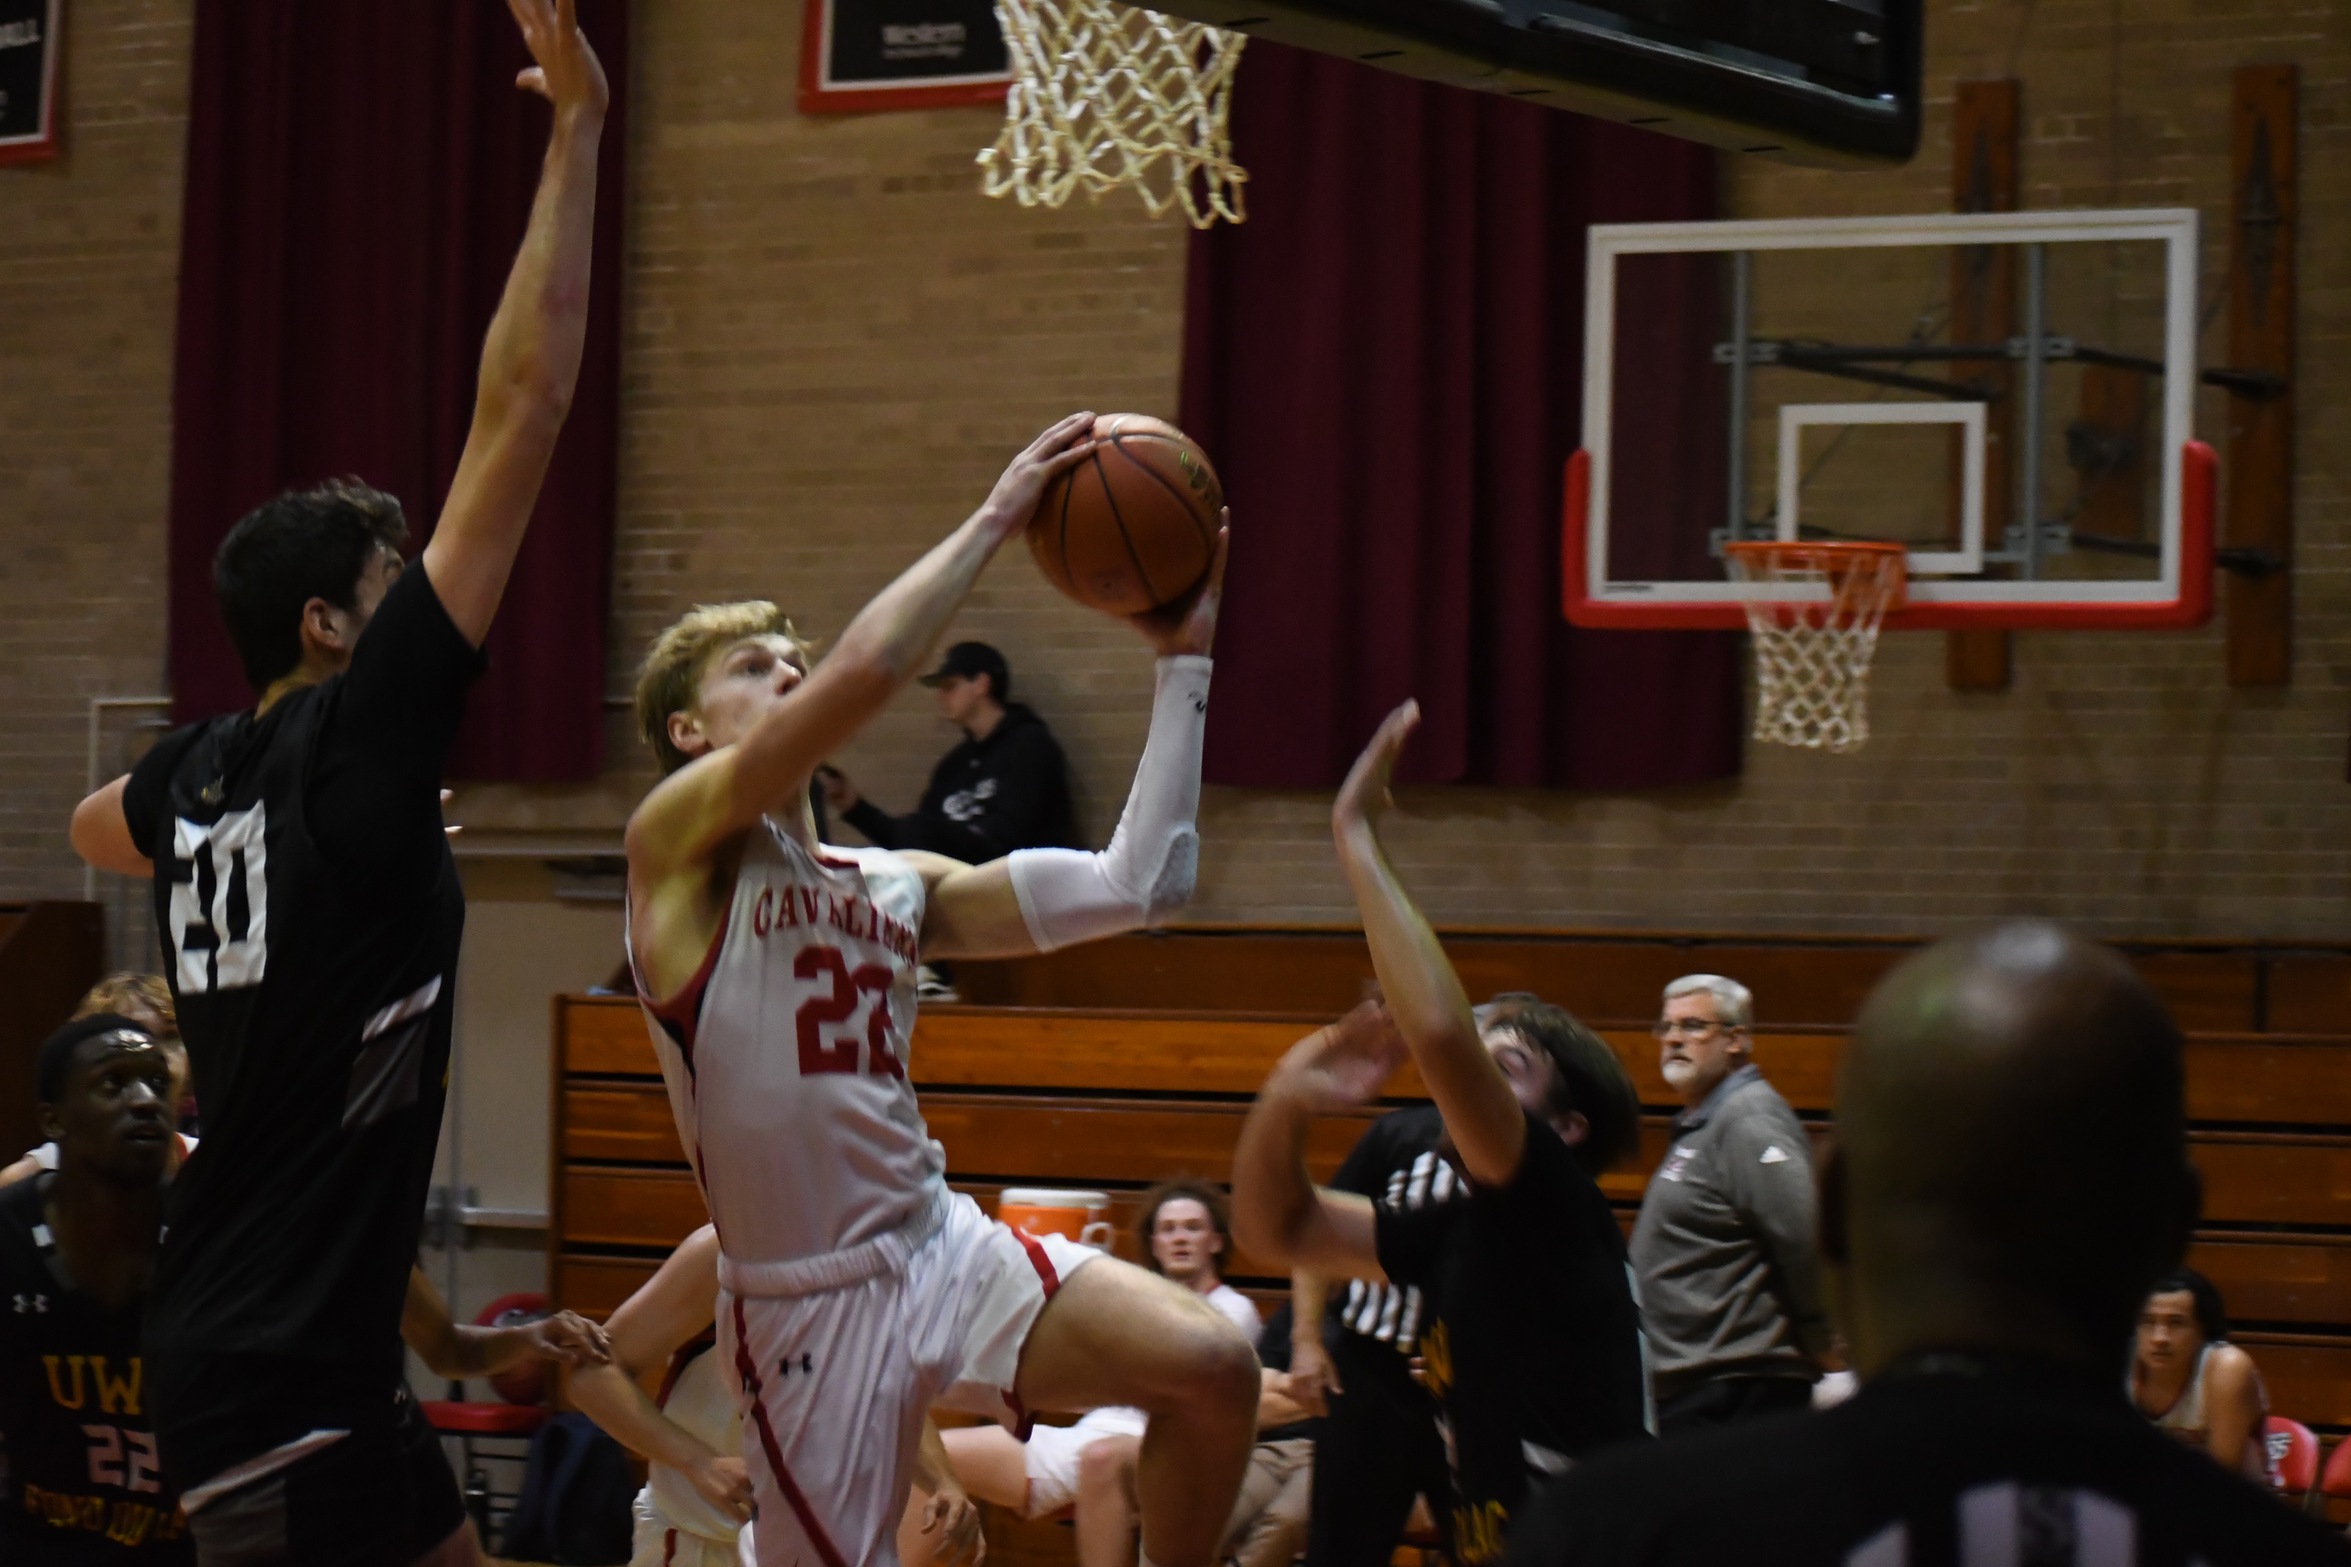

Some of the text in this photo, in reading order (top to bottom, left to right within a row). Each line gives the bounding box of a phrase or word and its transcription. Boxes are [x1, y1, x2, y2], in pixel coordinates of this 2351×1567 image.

[169, 799, 267, 995] 20
[754, 884, 916, 968] CAVALI
[794, 945, 903, 1080] 22
[41, 1355, 143, 1416] UW
[80, 1424, 163, 1495] 22
